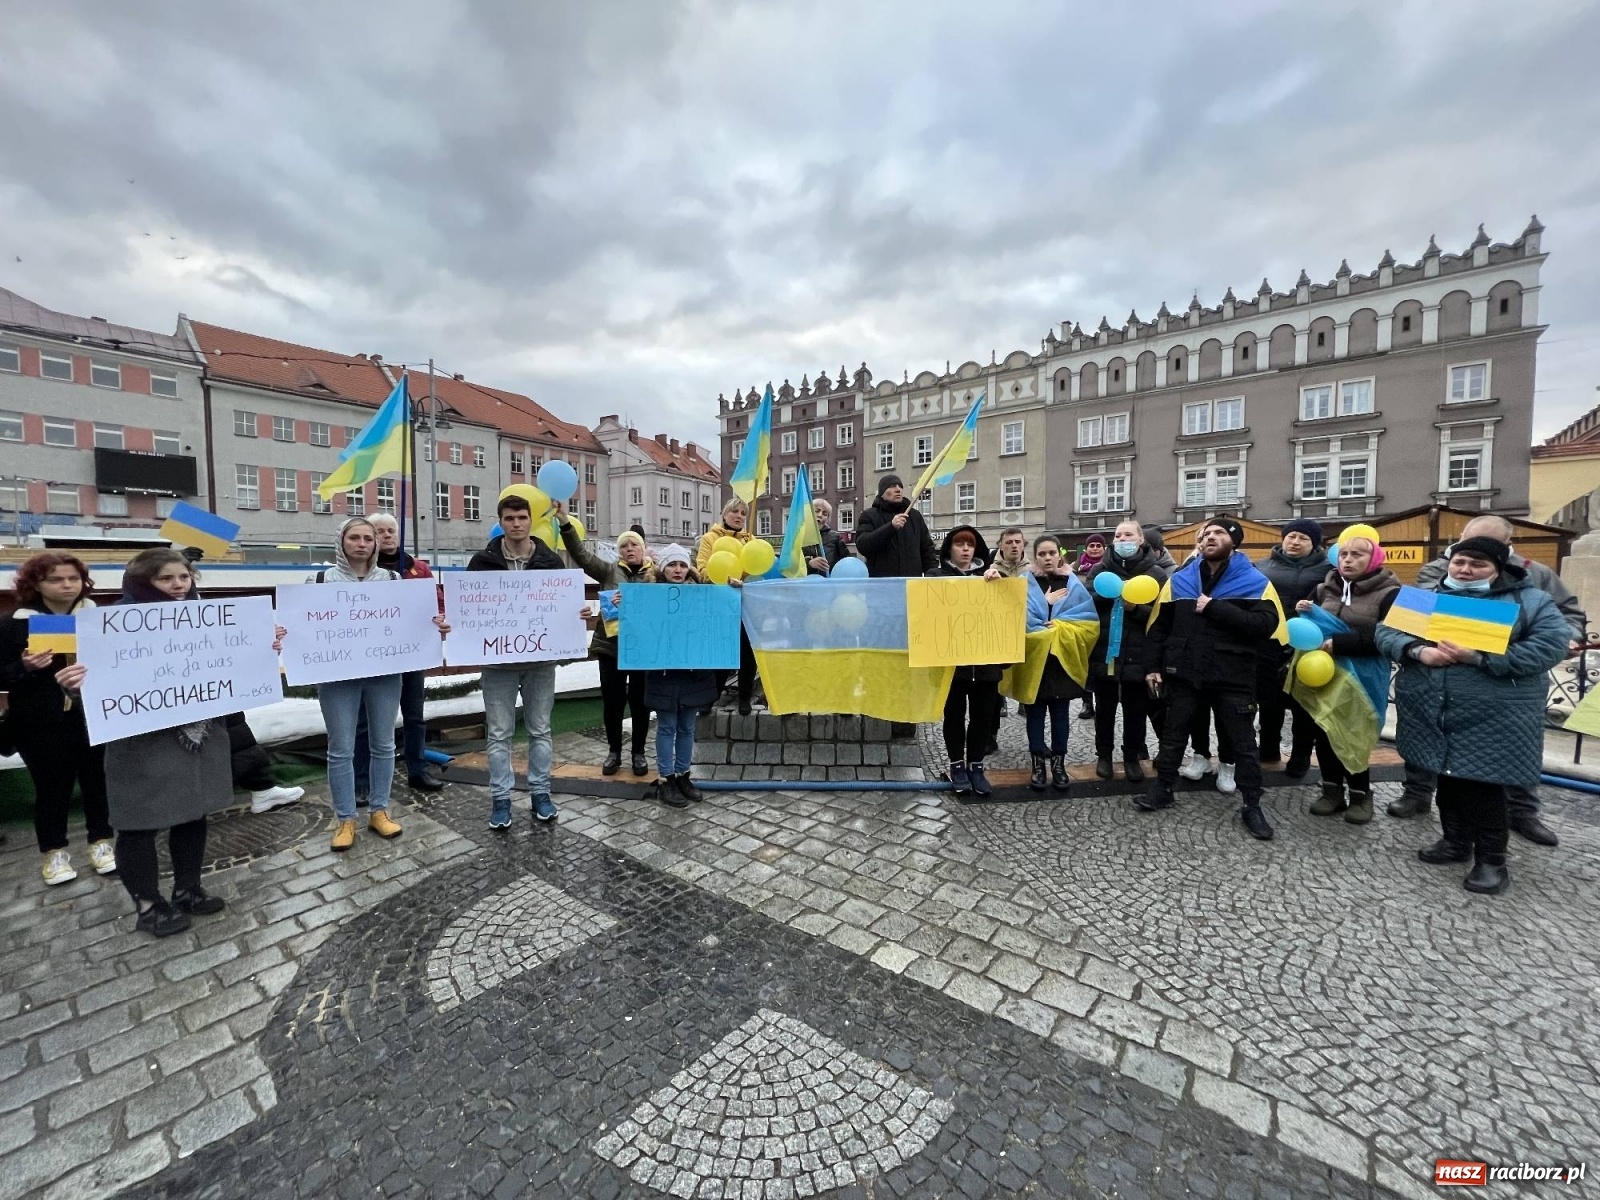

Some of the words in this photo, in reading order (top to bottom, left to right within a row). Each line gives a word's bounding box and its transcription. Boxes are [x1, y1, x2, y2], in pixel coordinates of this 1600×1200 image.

[457, 579, 489, 590] Teraz
[336, 590, 371, 608] Пусть
[459, 591, 507, 606] nadzieja
[926, 581, 960, 608] NO
[102, 604, 236, 635] KOCHAJCIE
[307, 610, 339, 621] МИР
[349, 606, 401, 621] БОЖИЙ
[528, 615, 545, 630] jest
[315, 627, 369, 645] правит
[111, 641, 153, 669] jedni
[163, 636, 214, 657] drugich
[152, 663, 175, 682] jak
[207, 656, 233, 669] was
[101, 679, 234, 720] POKOCHAŁEM
